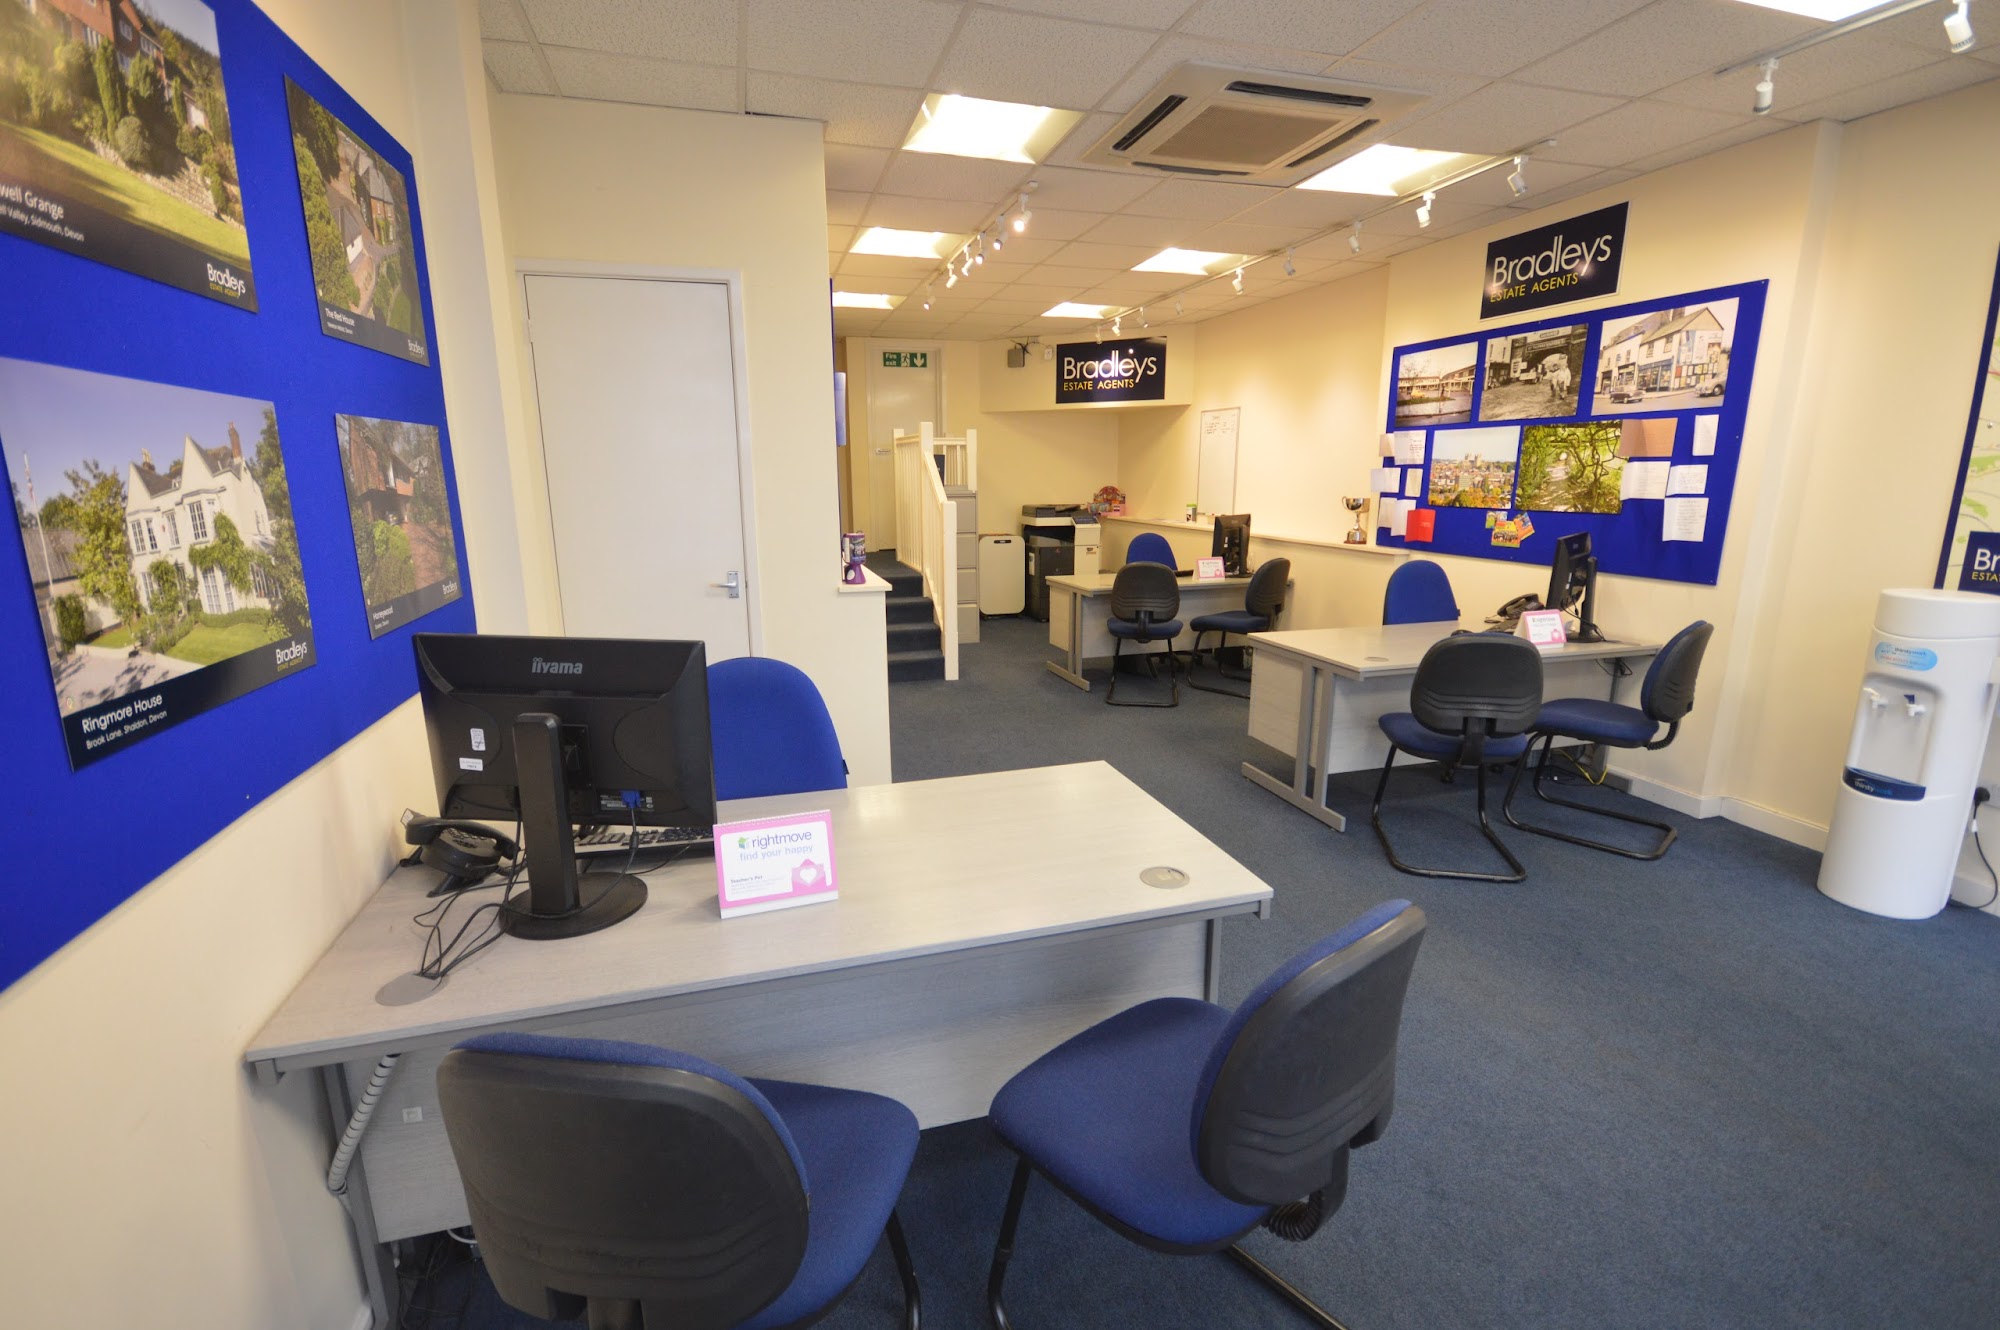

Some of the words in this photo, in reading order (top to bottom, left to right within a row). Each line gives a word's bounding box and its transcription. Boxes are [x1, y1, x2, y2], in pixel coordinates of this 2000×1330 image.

[25, 191, 64, 220] Grange
[64, 226, 85, 242] Devon
[1493, 235, 1613, 288] Bradleys
[207, 263, 246, 299] Bradleys
[1490, 284, 1526, 303] ESTATE
[1531, 272, 1579, 294] AGENTS
[408, 339, 425, 357] Bradleys
[1063, 350, 1157, 383] Bradleys
[1063, 381, 1093, 391] ESTATE
[1097, 379, 1135, 390] AGENTS
[1972, 572, 2000, 582] ESTA
[442, 581, 458, 594] Bradleys
[276, 641, 307, 664] Bradleys
[532, 657, 583, 674] iiyama
[82, 706, 133, 734] Ringmore
[134, 695, 162, 714] House
[86, 736, 105, 750] Brook
[149, 711, 167, 723] Devon
[752, 831, 812, 849] rightmove
[740, 852, 758, 861] find
[761, 849, 781, 862] your
[785, 845, 813, 857] happy
